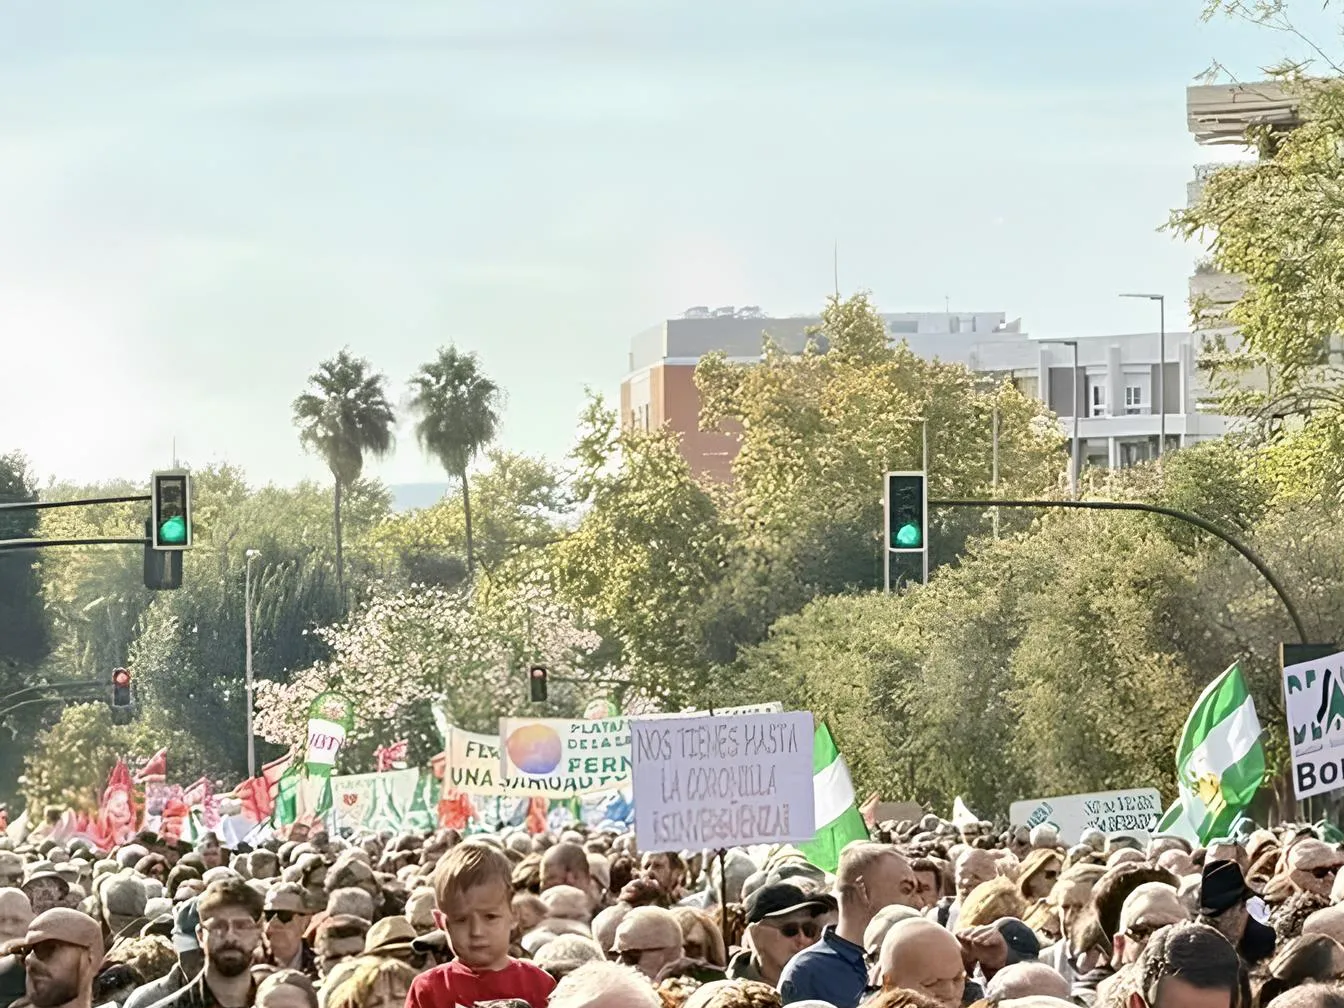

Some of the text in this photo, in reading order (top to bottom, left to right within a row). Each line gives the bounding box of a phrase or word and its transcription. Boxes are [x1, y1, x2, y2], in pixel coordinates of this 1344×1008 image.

[637, 723, 798, 764] NOS TIENES HASTA
[451, 767, 493, 786] UNA
[661, 768, 682, 803] LA
